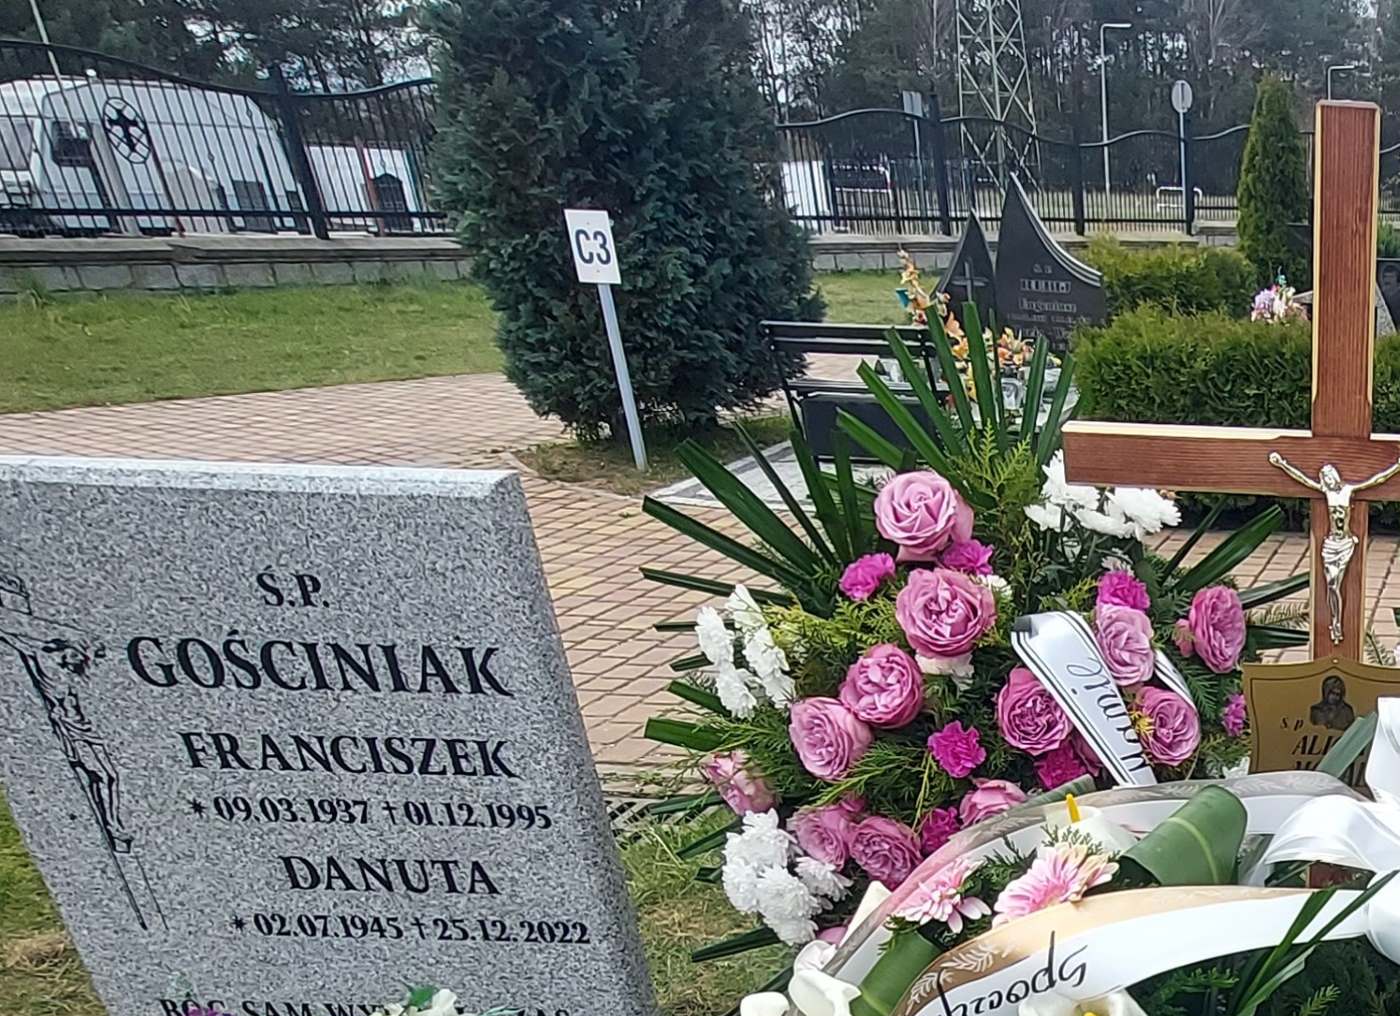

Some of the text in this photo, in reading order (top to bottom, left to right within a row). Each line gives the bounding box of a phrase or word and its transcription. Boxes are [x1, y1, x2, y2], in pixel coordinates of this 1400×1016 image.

[575, 229, 611, 265] C3
[126, 630, 514, 698] GOŚCINIAK
[179, 731, 519, 779] FRANCISZEK
[279, 854, 501, 897] DANUTA
[432, 917, 591, 945] 25.12.2022
